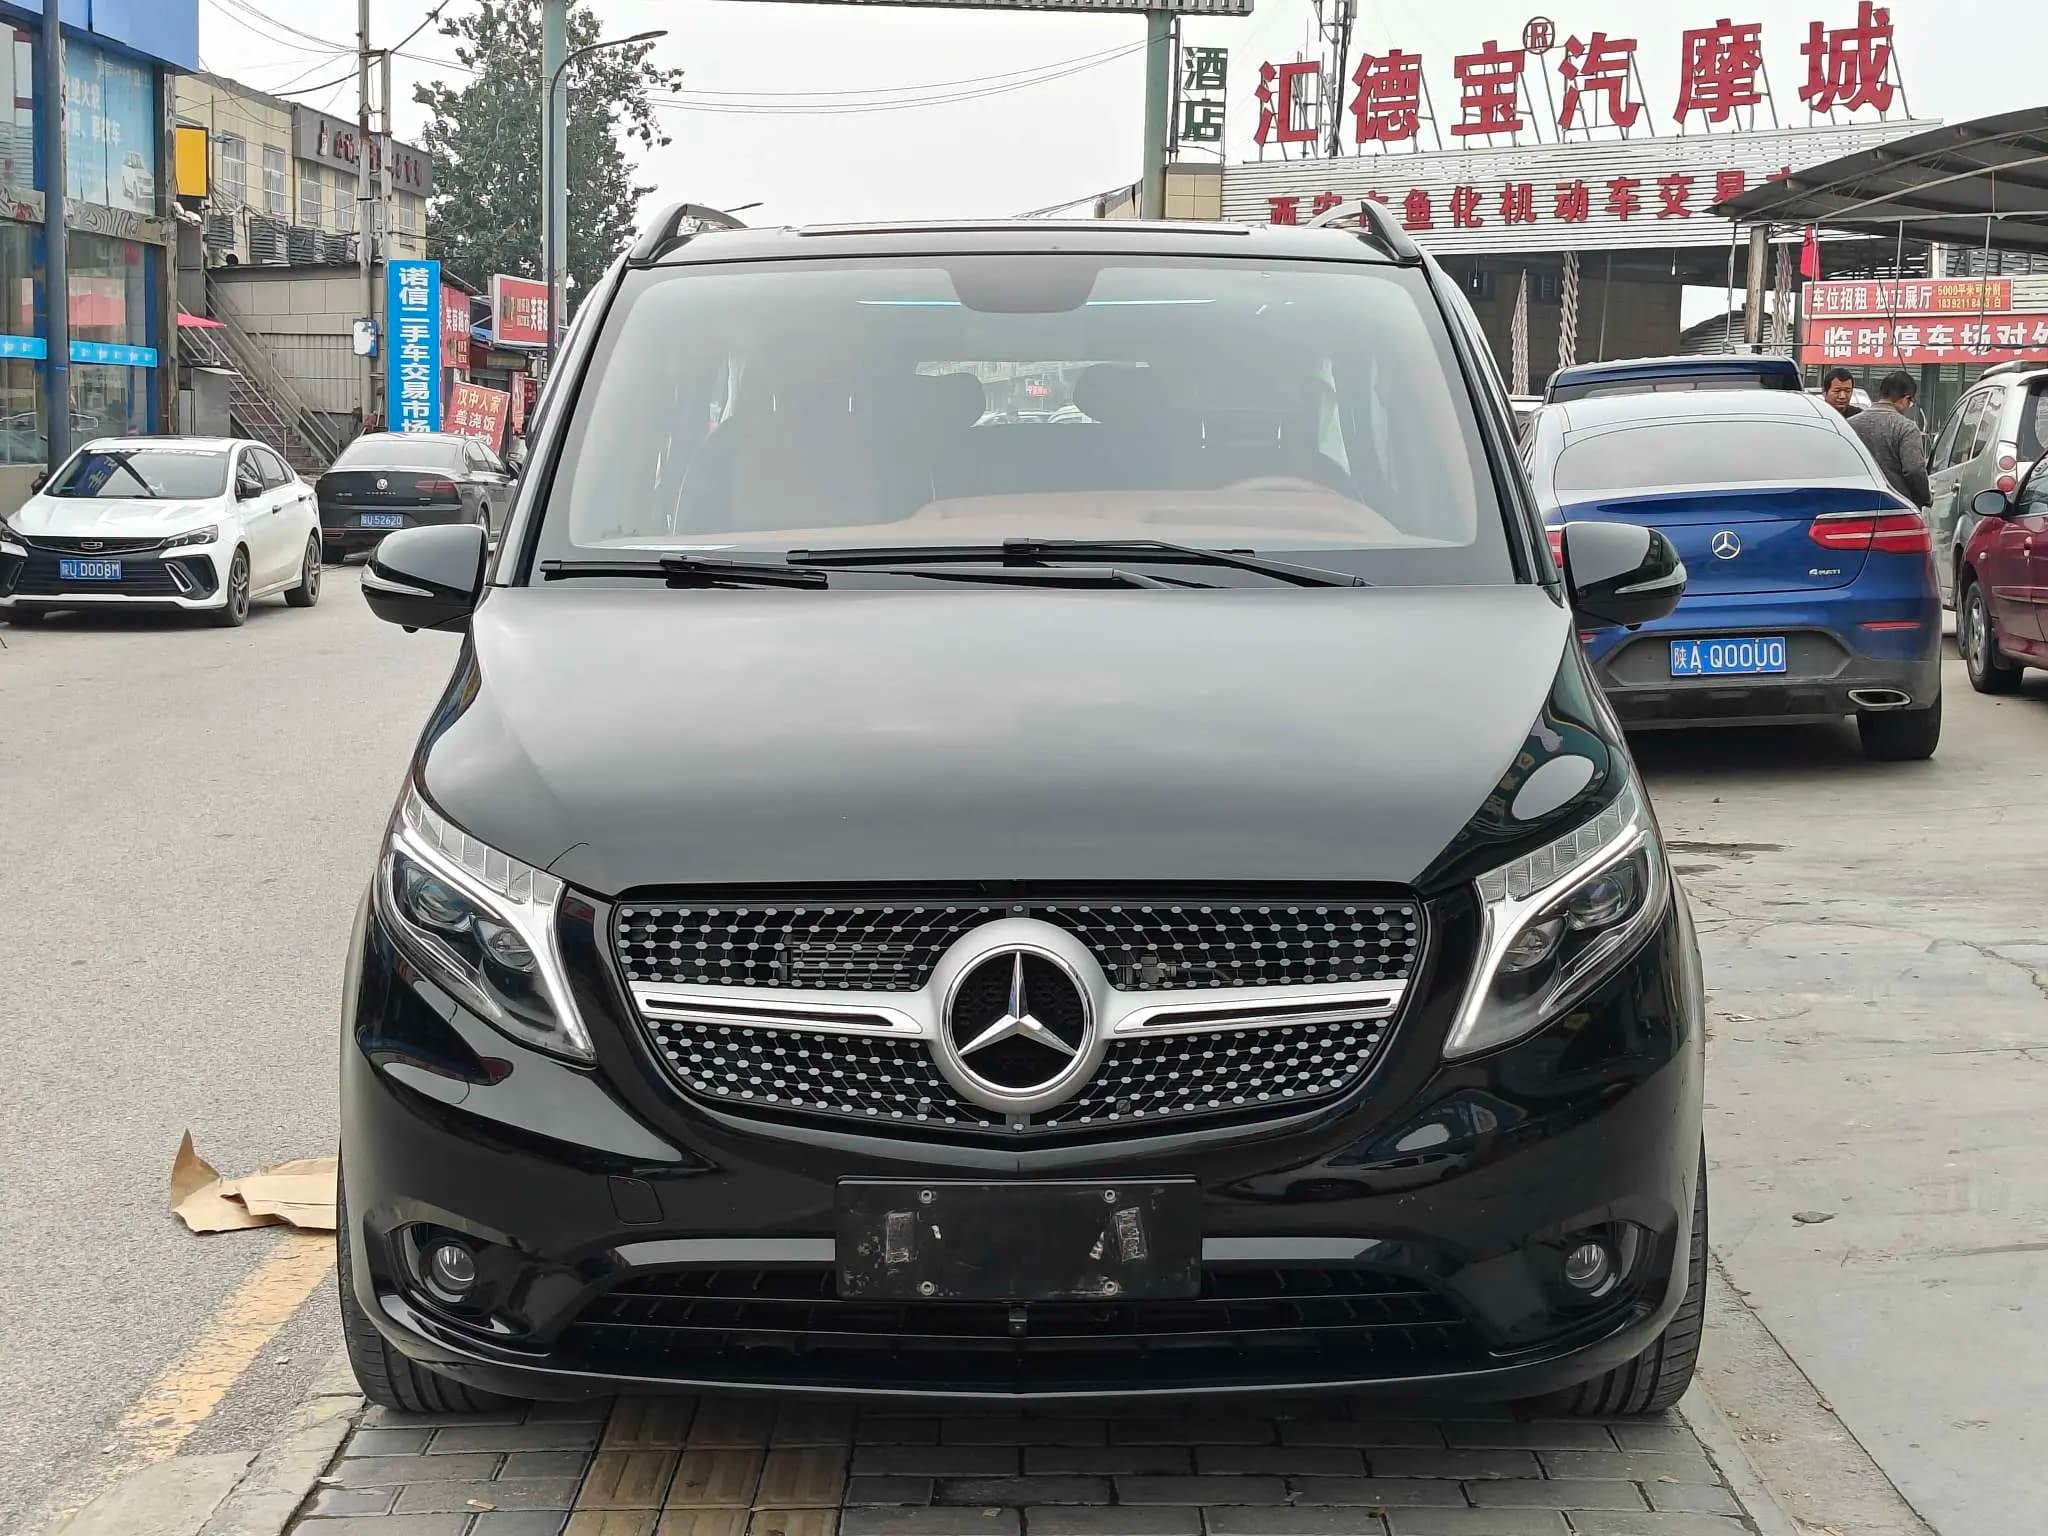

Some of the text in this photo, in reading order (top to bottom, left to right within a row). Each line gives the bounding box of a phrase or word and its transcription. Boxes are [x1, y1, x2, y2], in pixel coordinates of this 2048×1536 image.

[1181, 47, 1228, 142] 酒店
[1268, 166, 1790, 230] 西安鱼化机动车交易
[1813, 284, 1933, 311] 车位招租 独立展厅
[398, 268, 432, 432] 诺信二手车交易市场
[454, 409, 497, 432] 盖浇饭
[457, 389, 502, 414] 汉中人家
